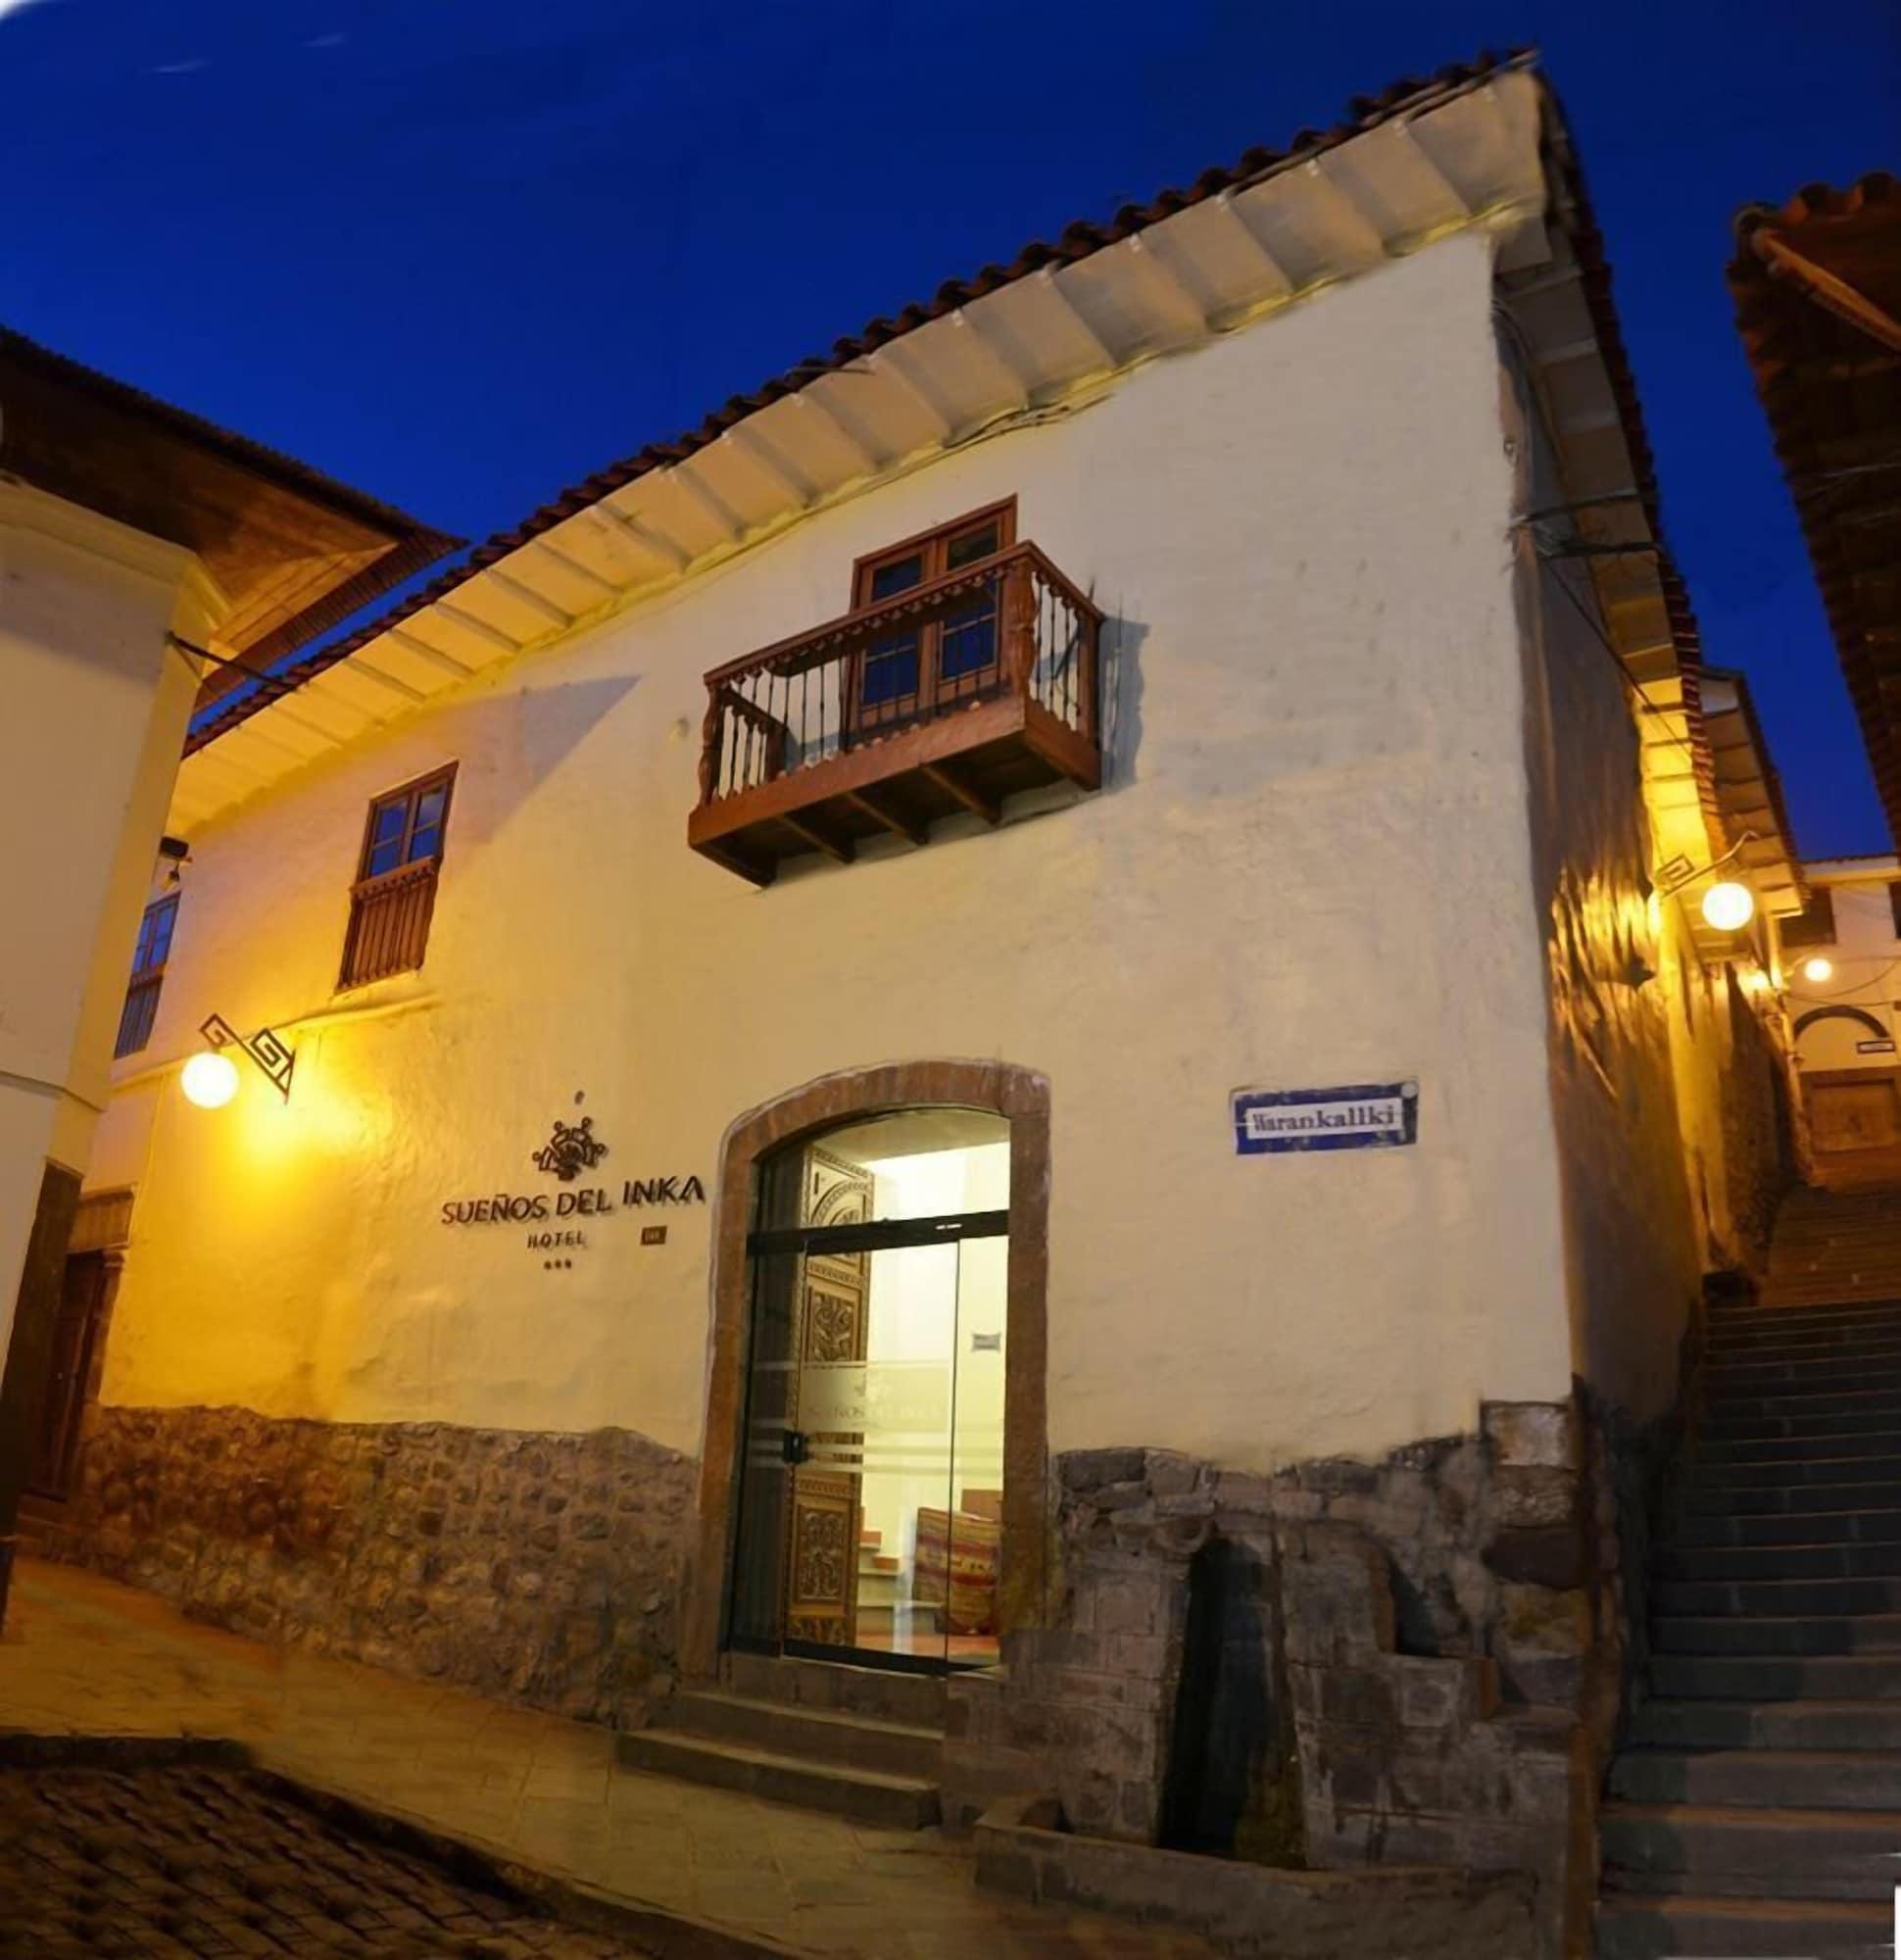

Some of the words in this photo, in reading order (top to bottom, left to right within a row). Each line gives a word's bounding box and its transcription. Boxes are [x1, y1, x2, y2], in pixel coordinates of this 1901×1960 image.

[441, 1194, 548, 1225] SUEÑOS
[556, 1189, 612, 1217] DEL
[622, 1176, 706, 1205] INKA
[526, 1231, 586, 1250] HOTEL
